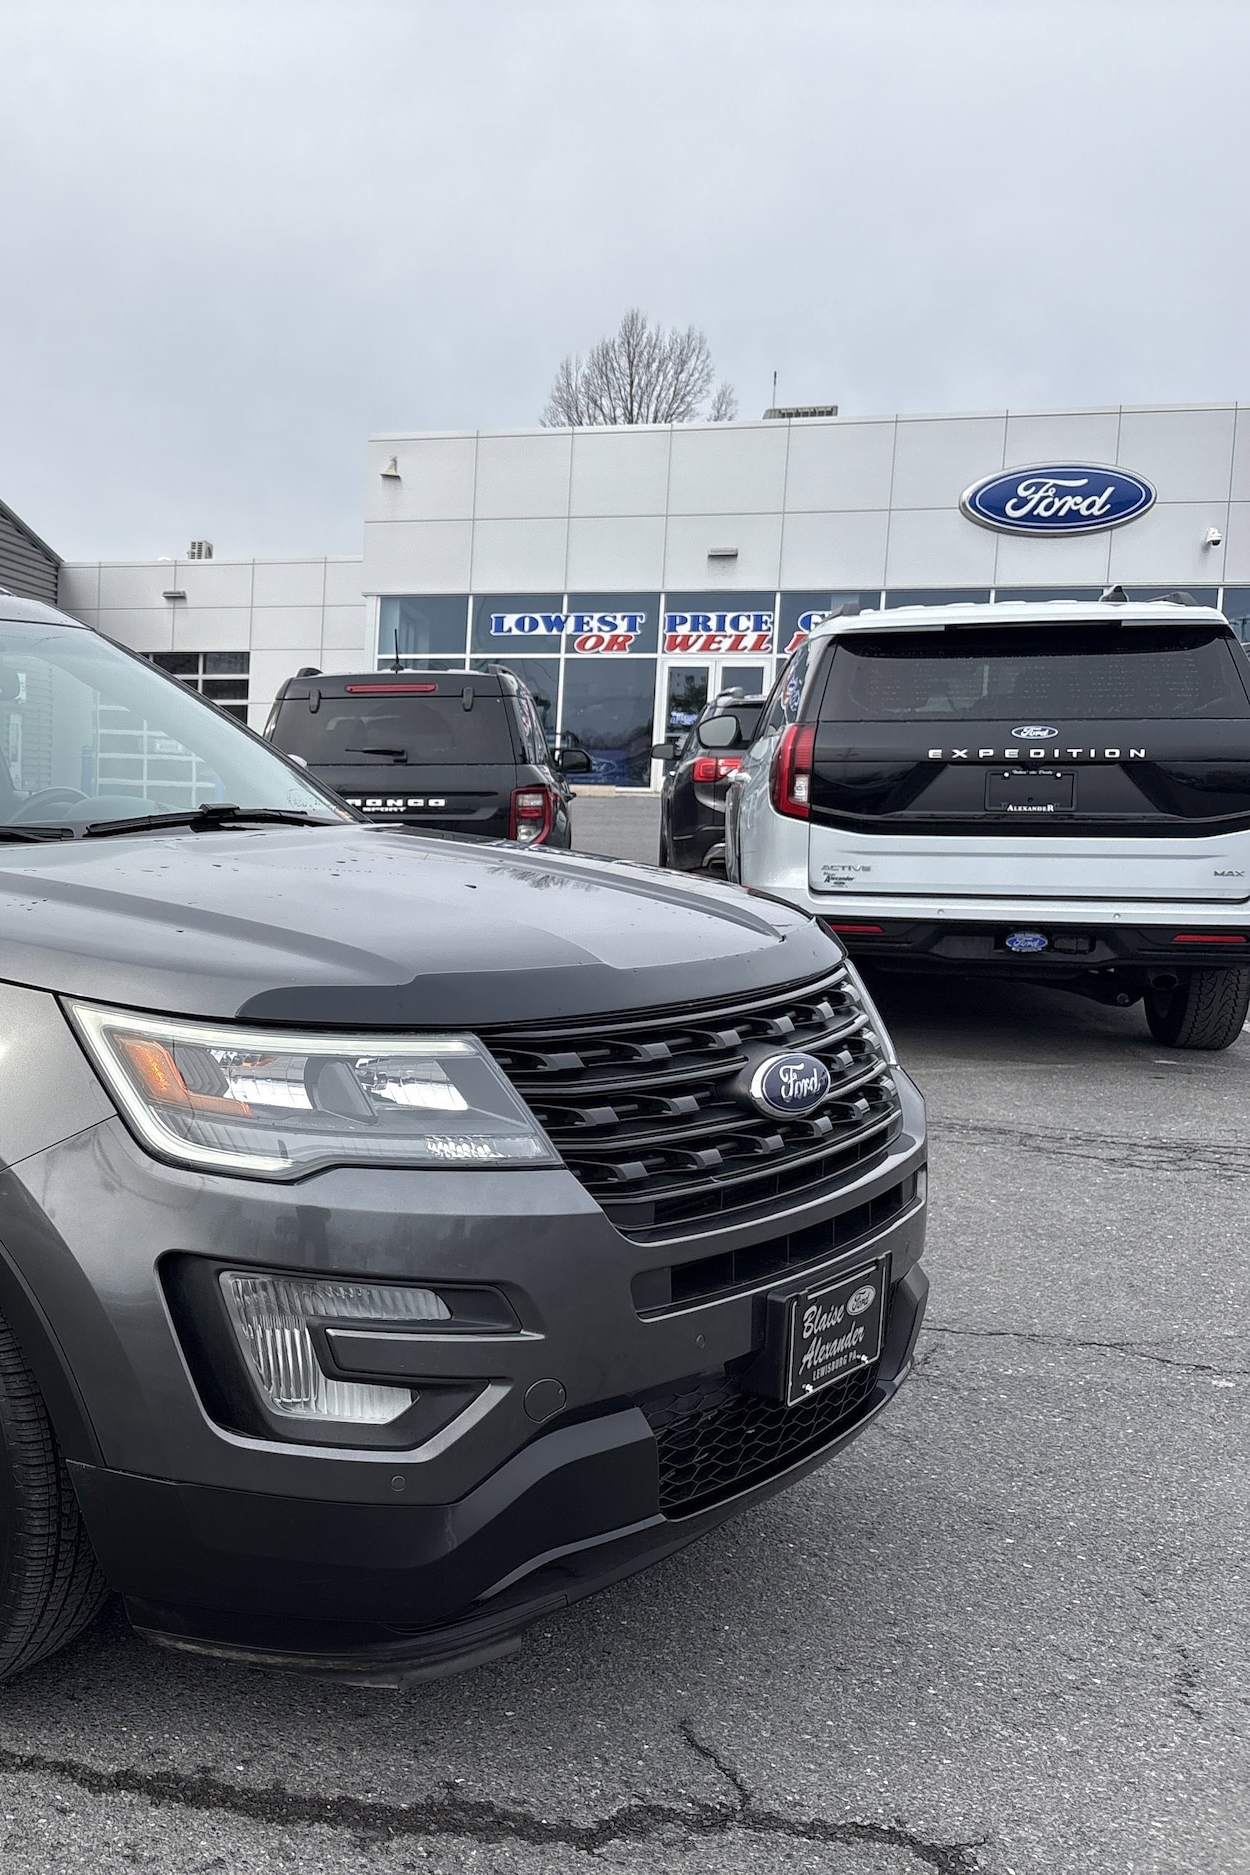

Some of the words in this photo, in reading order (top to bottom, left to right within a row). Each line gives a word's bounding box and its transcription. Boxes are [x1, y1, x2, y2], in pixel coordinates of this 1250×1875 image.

[1005, 478, 1116, 518] Ford
[491, 613, 645, 635] LOWEST
[664, 612, 773, 633] PRICE
[575, 634, 634, 653] OR
[663, 634, 772, 652] WELL
[1020, 727, 1051, 738] Ford
[927, 748, 1147, 759] EXPEDITION
[821, 864, 871, 872] ACTIVE
[1213, 870, 1246, 878] MAX
[779, 1062, 822, 1103] Ford
[802, 1304, 846, 1340] Blaise
[798, 1320, 865, 1376] Alexander
[812, 1353, 848, 1382] LEWISBURG
